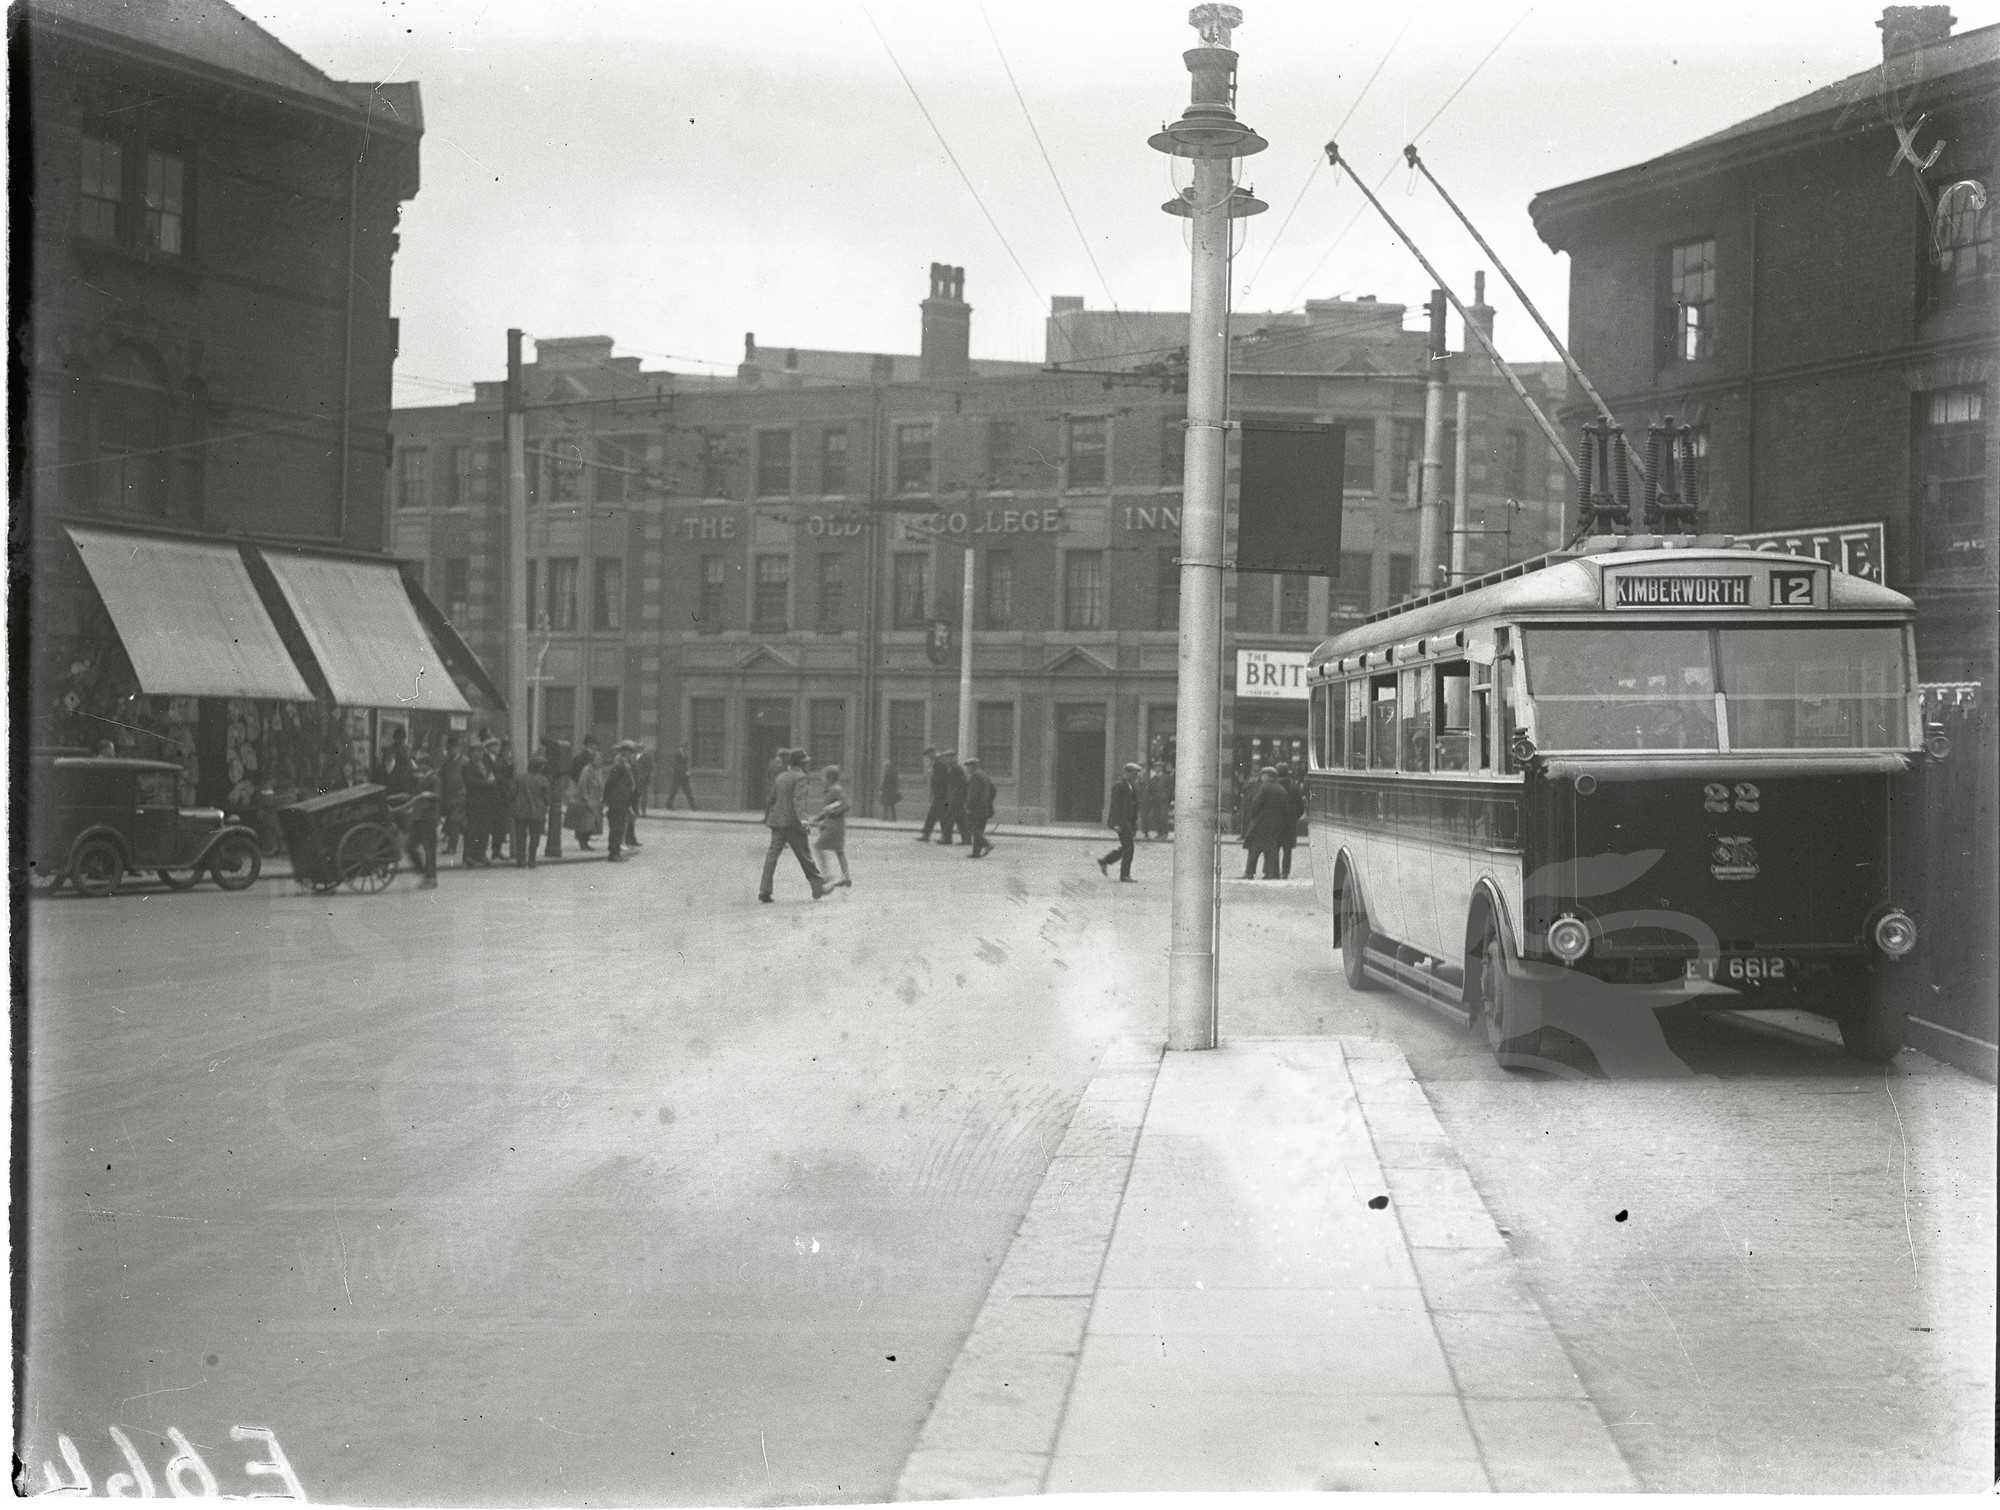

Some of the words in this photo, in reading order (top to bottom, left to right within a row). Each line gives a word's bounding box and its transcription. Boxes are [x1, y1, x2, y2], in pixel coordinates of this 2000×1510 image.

[684, 517, 736, 539] THE
[807, 515, 861, 536] OLD
[1125, 507, 1181, 530] INN
[1616, 578, 1745, 602] KIMBERWORTH
[1771, 577, 1810, 604] 12
[1248, 652, 1267, 662] THE
[1246, 662, 1305, 687] BRIT
[1703, 783, 1760, 812] 22
[1686, 959, 1718, 979] ET
[1728, 957, 1785, 979] 6612
